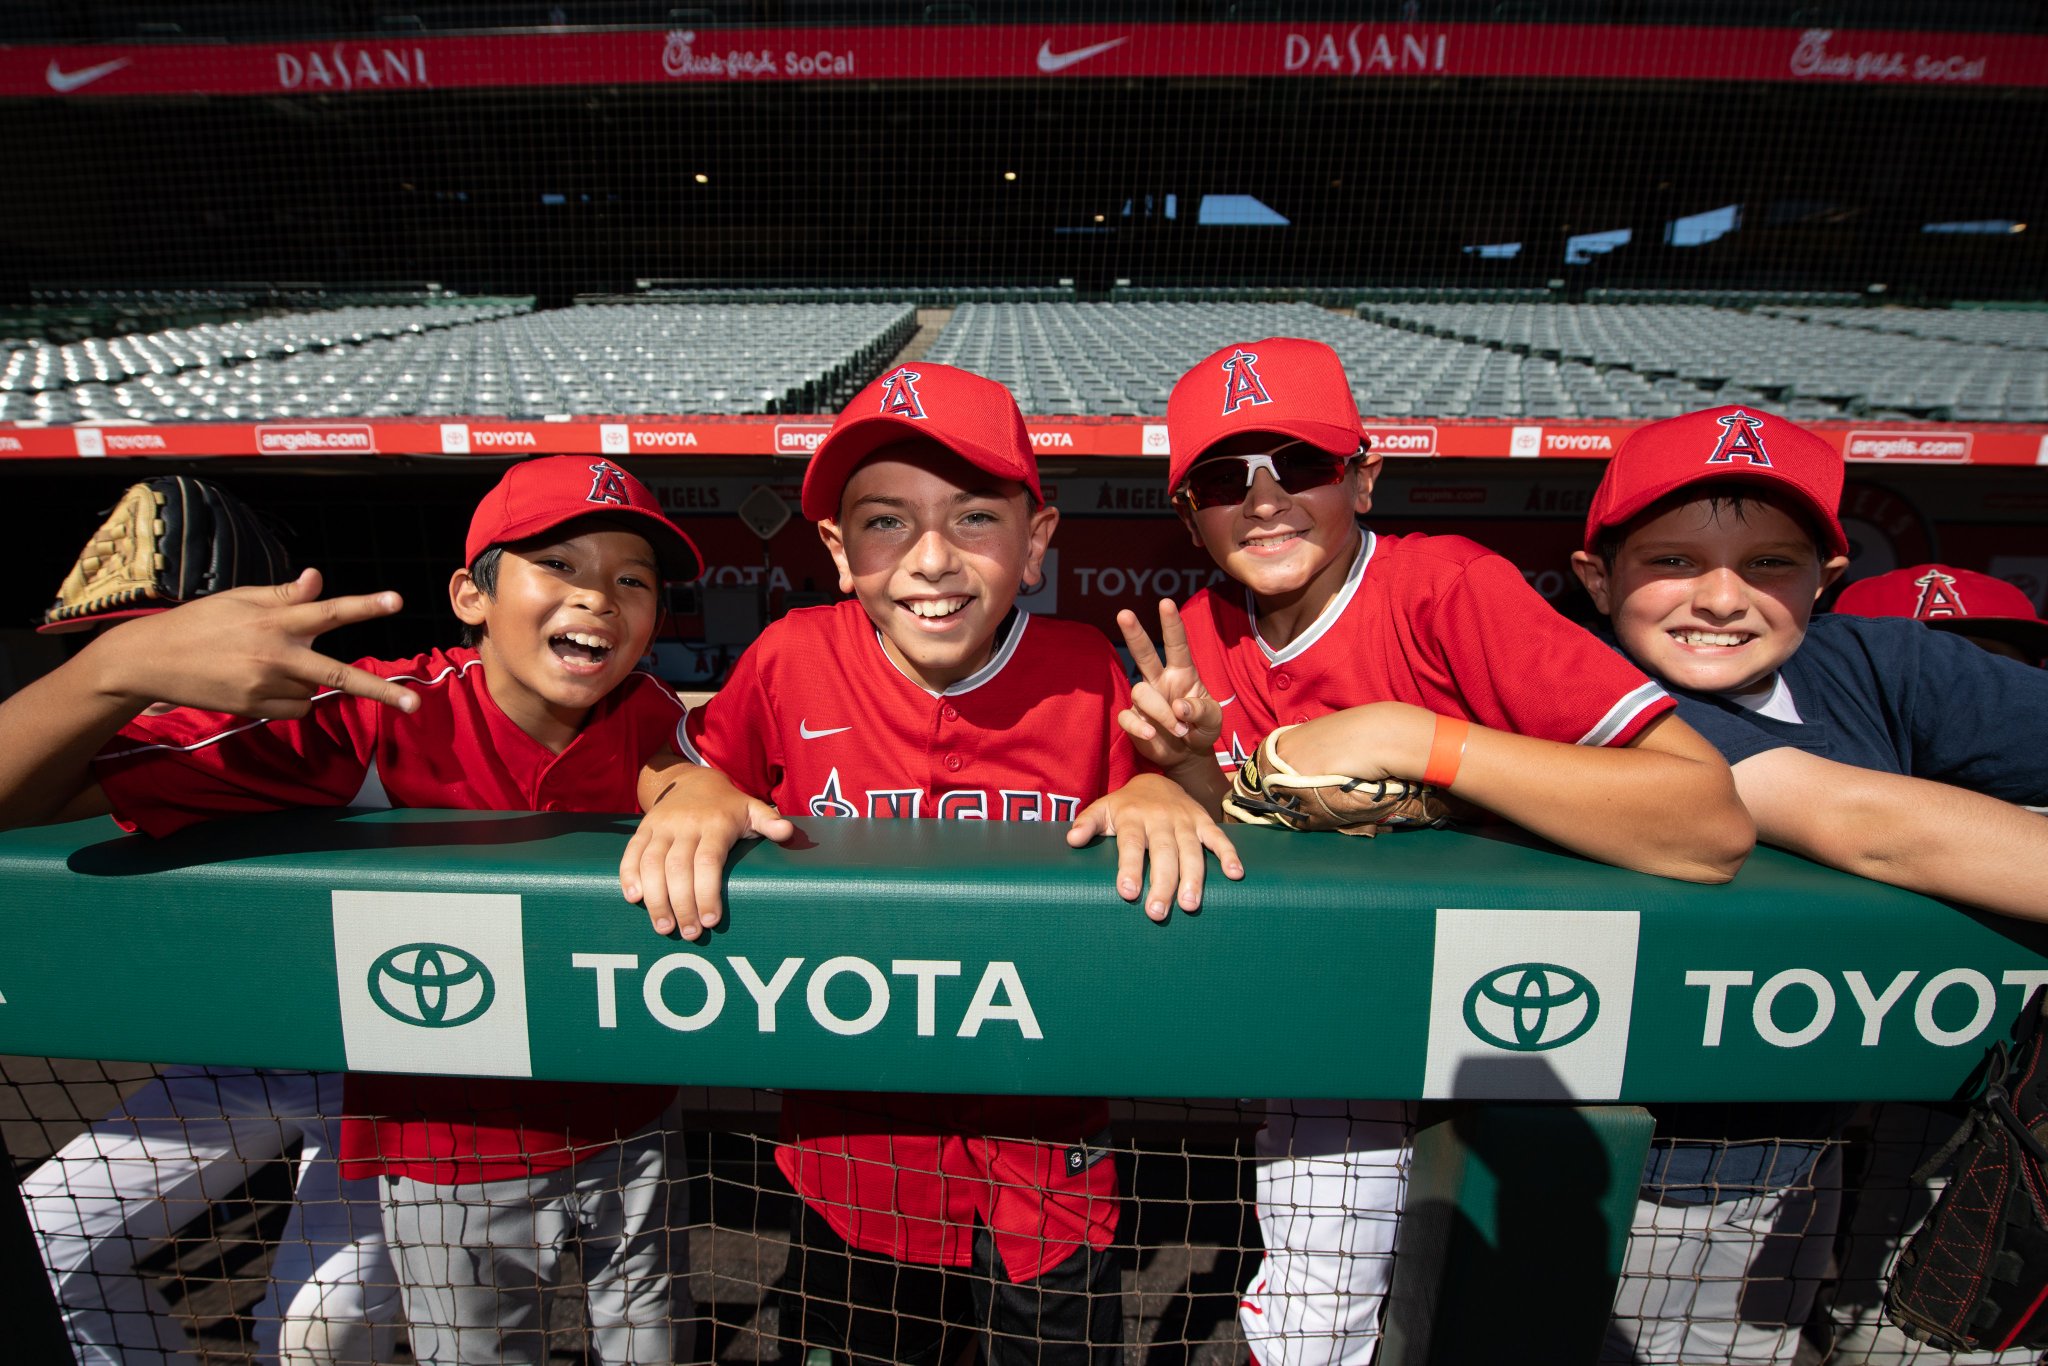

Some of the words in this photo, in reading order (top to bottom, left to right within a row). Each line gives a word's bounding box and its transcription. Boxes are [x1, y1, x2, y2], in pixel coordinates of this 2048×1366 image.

[1284, 23, 1448, 77] DASANI
[277, 43, 428, 92] DASANI
[785, 50, 854, 75] SoCal
[104, 434, 167, 449] TOYOTA
[261, 432, 368, 451] angels.com
[473, 431, 537, 446] TOYOTA
[634, 432, 698, 447] TOYOTA
[1028, 432, 1073, 447] YOTA
[1369, 434, 1430, 449] s.com
[1545, 434, 1612, 450] TOYOTA
[1850, 438, 1965, 458] angels.com
[653, 487, 720, 508] NGELS
[1096, 481, 1174, 510] ANGEL
[701, 565, 792, 592] YOTA
[572, 952, 1044, 1040] TOYOTA
[1685, 968, 2048, 1048] TOYOT
